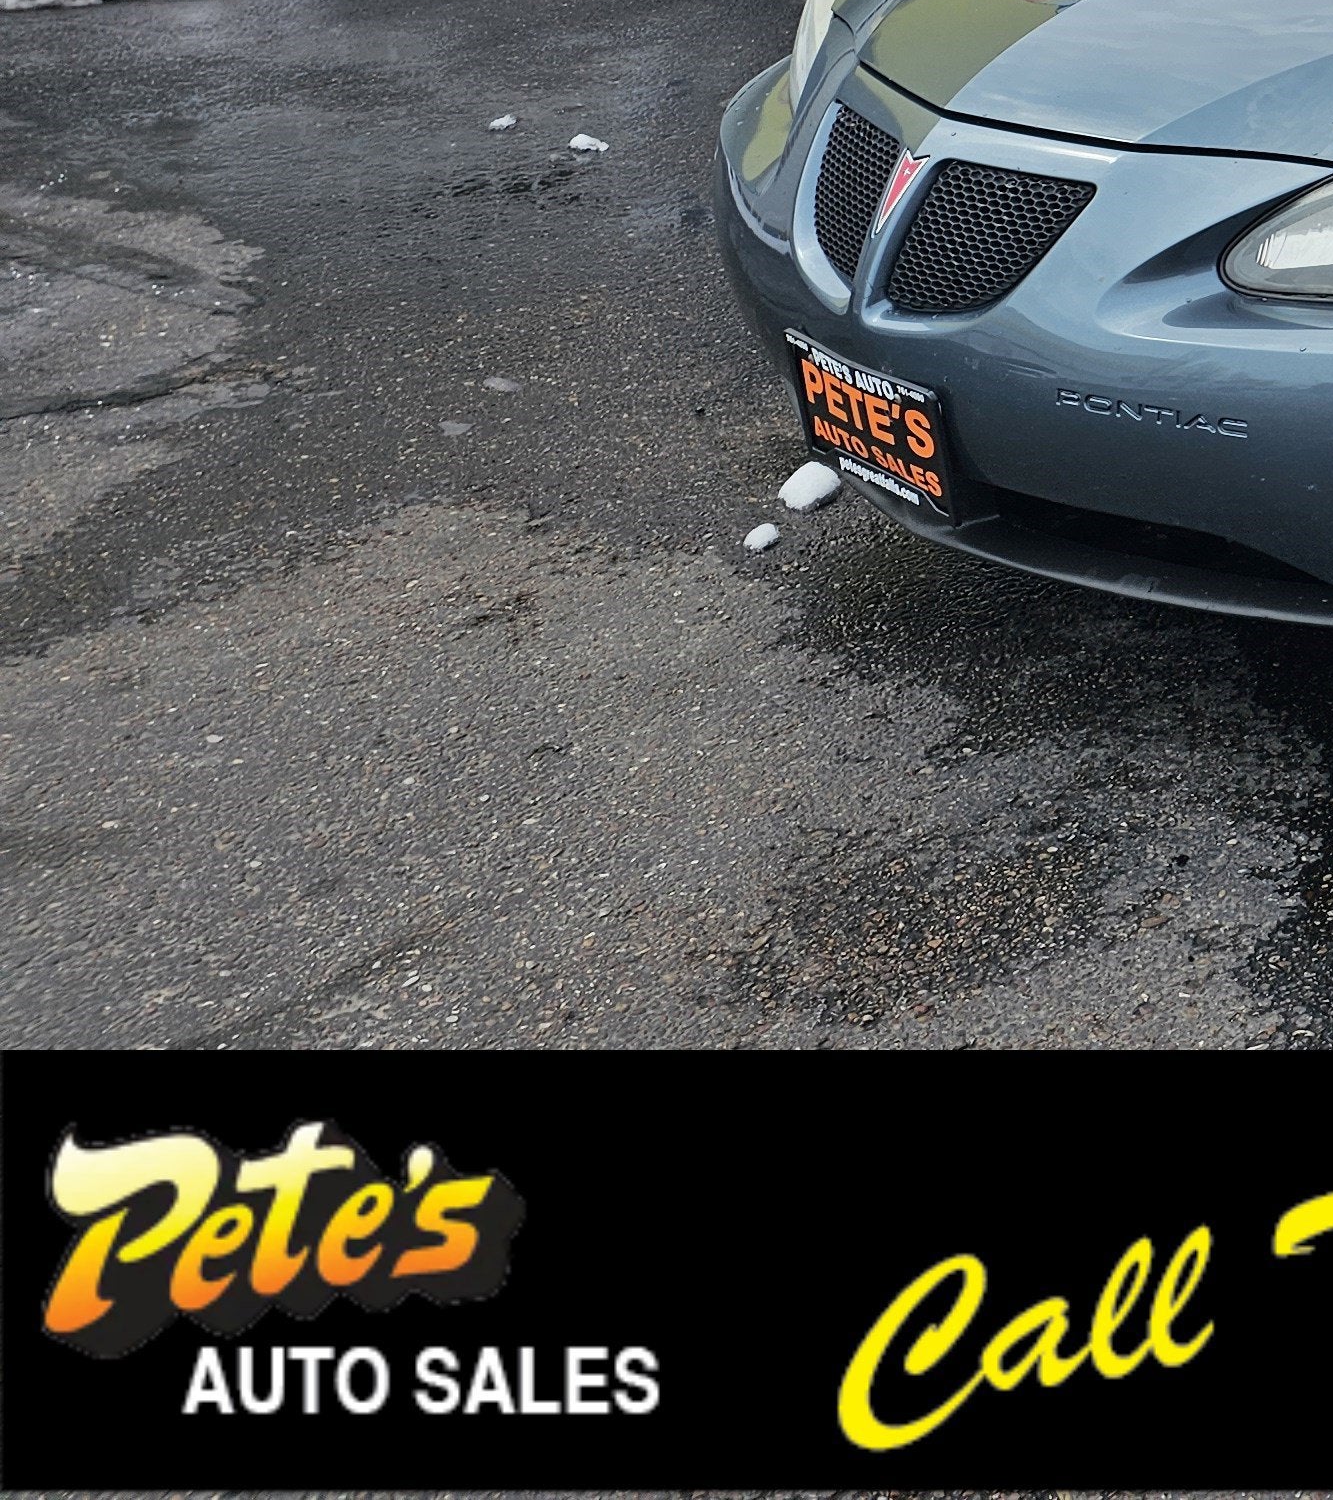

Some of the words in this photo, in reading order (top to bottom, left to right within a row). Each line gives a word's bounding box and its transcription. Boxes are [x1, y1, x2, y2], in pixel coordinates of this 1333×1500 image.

[801, 358, 935, 458] PETE'S
[811, 347, 853, 385] PETE'S
[855, 370, 895, 401] AUTO
[1055, 387, 1248, 438] PONTIAC
[814, 415, 869, 459] AUTO
[870, 445, 942, 497] SALES
